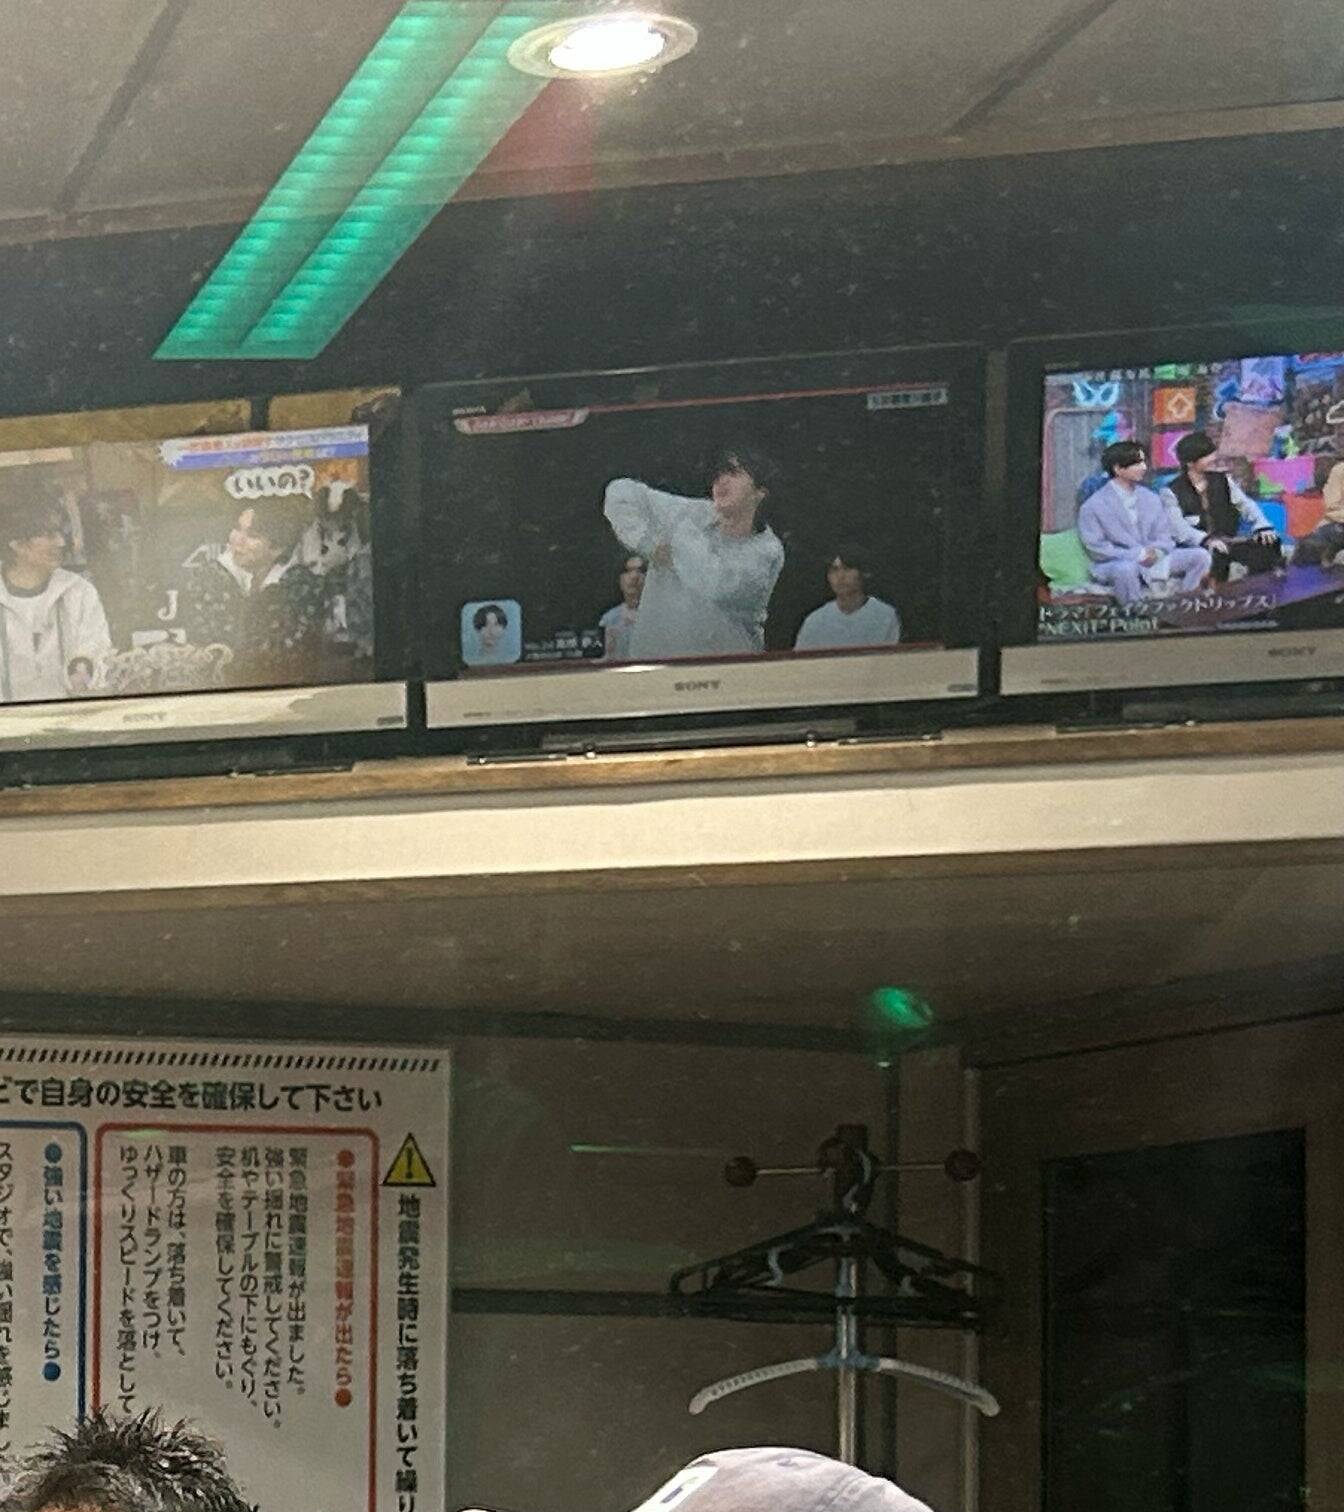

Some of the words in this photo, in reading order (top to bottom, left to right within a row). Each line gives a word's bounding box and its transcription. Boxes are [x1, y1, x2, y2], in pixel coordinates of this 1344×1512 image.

[674, 680, 720, 692] SONY
[142, 1145, 163, 1359] ハザードランプをつけ、
[215, 1146, 237, 1390] 安全を確保してください。
[240, 1146, 261, 1408] 机やテーブルの下にもぐり、
